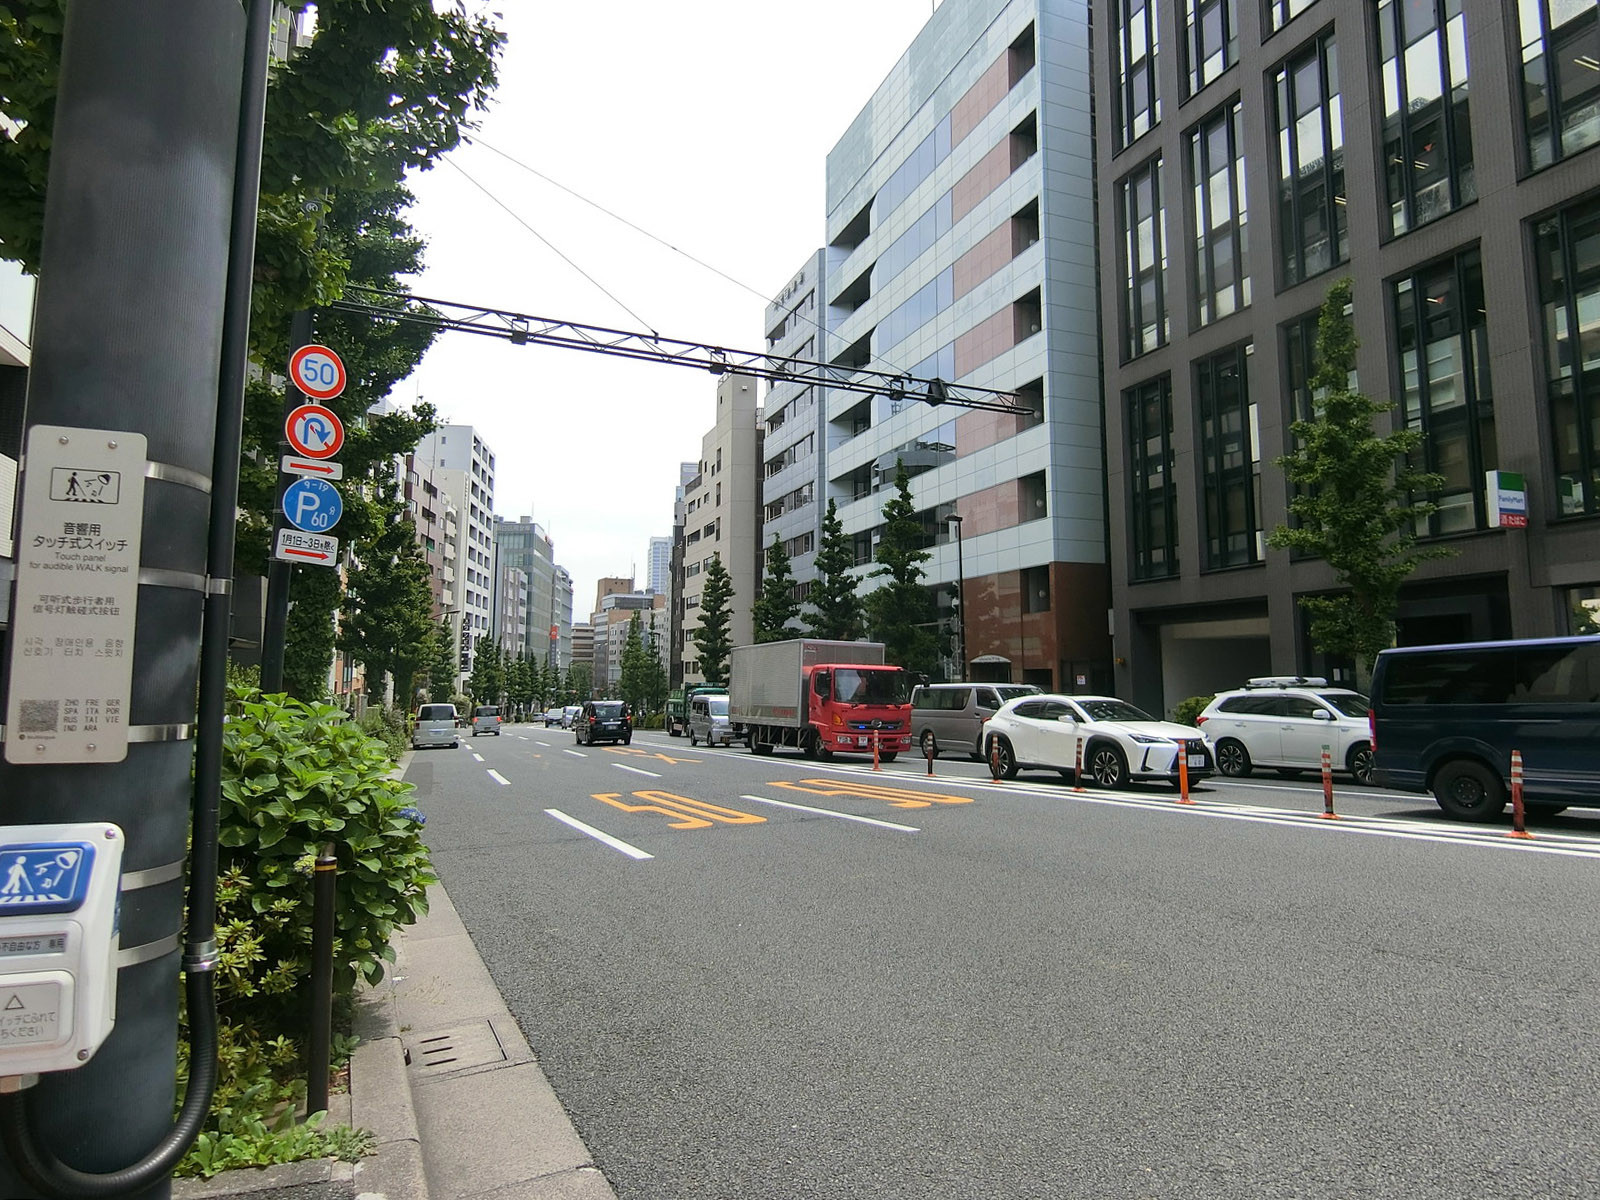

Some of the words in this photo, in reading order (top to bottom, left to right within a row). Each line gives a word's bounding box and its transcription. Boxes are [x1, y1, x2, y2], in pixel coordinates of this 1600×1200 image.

[304, 358, 335, 386] 50
[303, 480, 330, 492] 9-19
[1498, 495, 1524, 504] FamilyMart
[295, 491, 321, 524] P
[310, 511, 328, 528] 60
[63, 521, 102, 537] 音響用
[32, 535, 129, 552] タッチ式スイッチ
[54, 551, 80, 561] Touch
[82, 554, 107, 562] panel
[29, 561, 41, 570] for
[42, 561, 74, 571] audible
[75, 563, 102, 572] WALK
[104, 564, 129, 575] signal
[85, 698, 100, 707] FRE
[106, 698, 120, 707] GER
[63, 707, 79, 715] SPA
[85, 707, 99, 715] ITA
[105, 707, 120, 715] POR
[63, 715, 79, 724] RUS
[104, 716, 120, 724] VIE
[63, 724, 78, 732] IND
[83, 724, 98, 732] ARA
[756, 778, 976, 808] 50
[590, 789, 768, 830] 50
